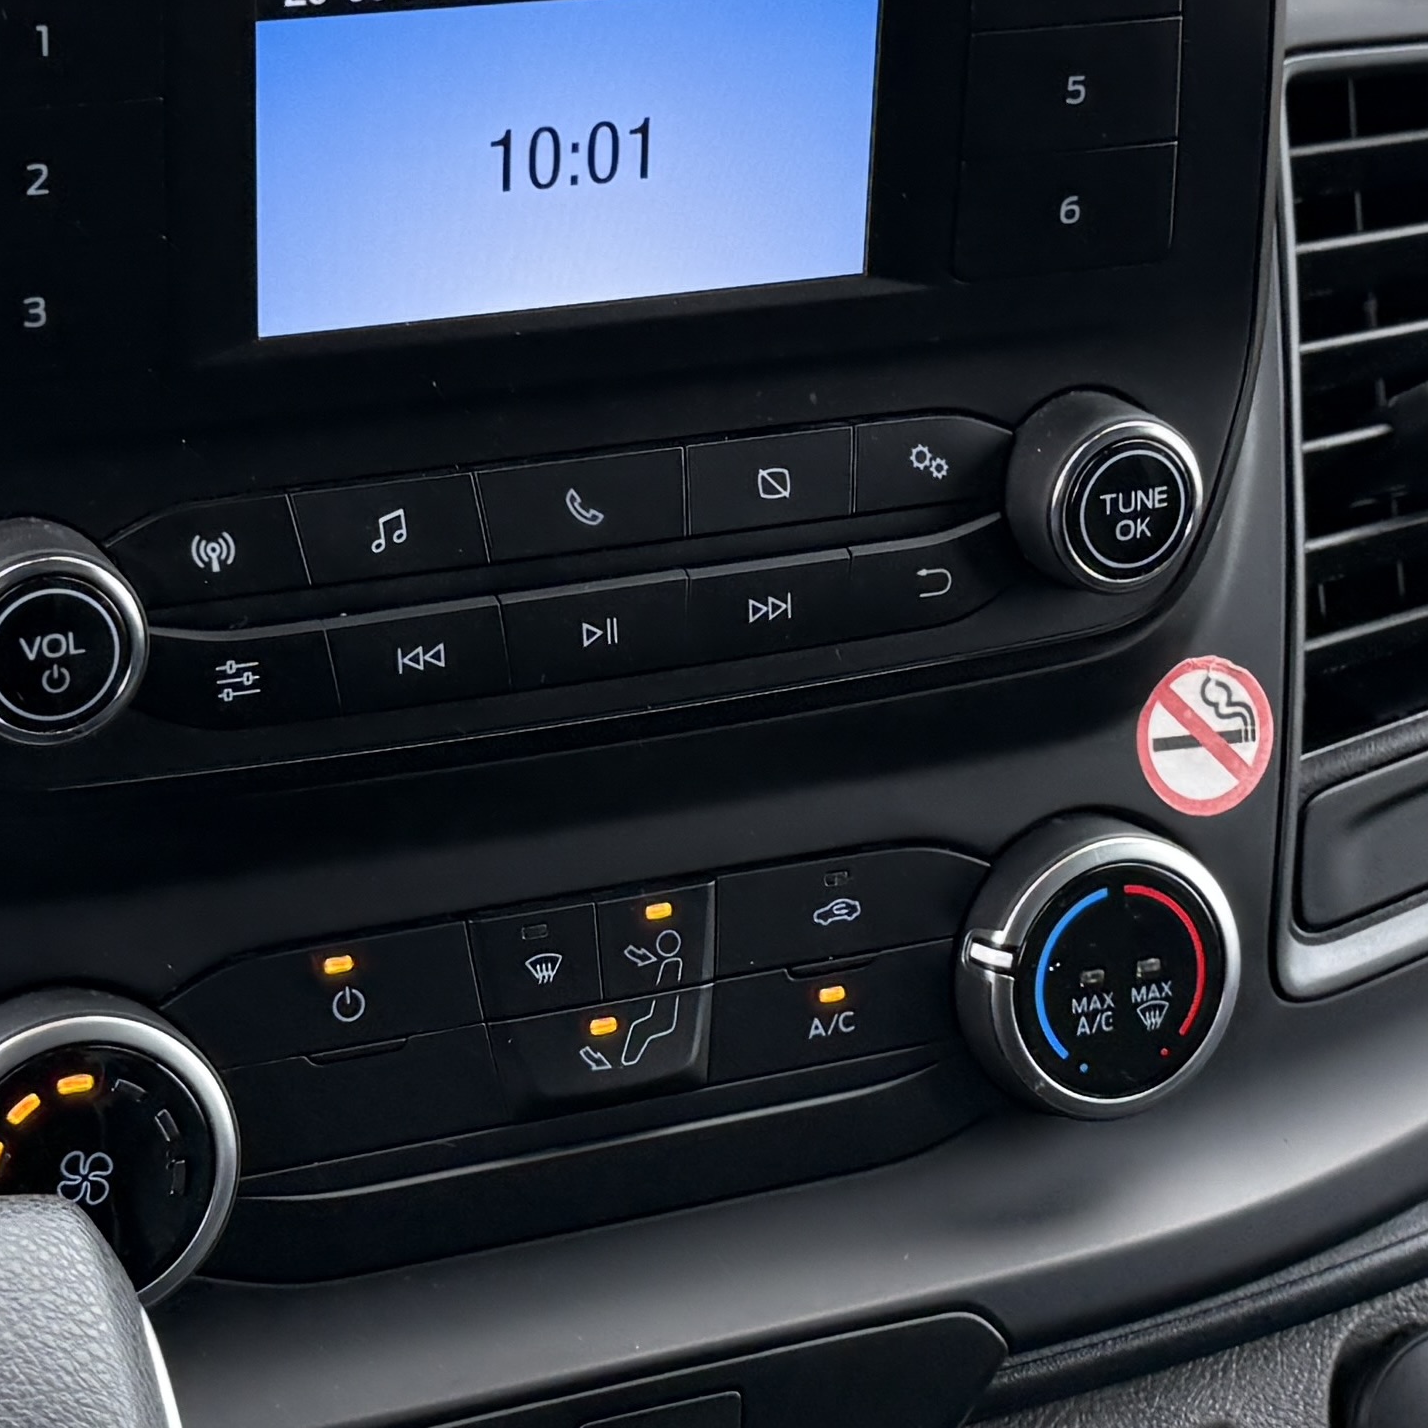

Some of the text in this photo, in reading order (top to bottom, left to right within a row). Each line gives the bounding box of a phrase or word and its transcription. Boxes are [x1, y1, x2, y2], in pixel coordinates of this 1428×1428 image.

[35, 24, 49, 57] 1
[1065, 75, 1086, 105] 5
[490, 116, 651, 193] 10:01
[26, 163, 50, 196] 2
[1059, 195, 1081, 224] 6
[23, 296, 47, 328] 3
[1099, 485, 1169, 516] TUNE
[1115, 516, 1152, 541] OK
[19, 631, 86, 661] VOL
[1071, 991, 1115, 1015] MAX
[1131, 980, 1173, 1003] MAX
[808, 1011, 857, 1039] A/C
[1076, 1011, 1114, 1037] A/C
